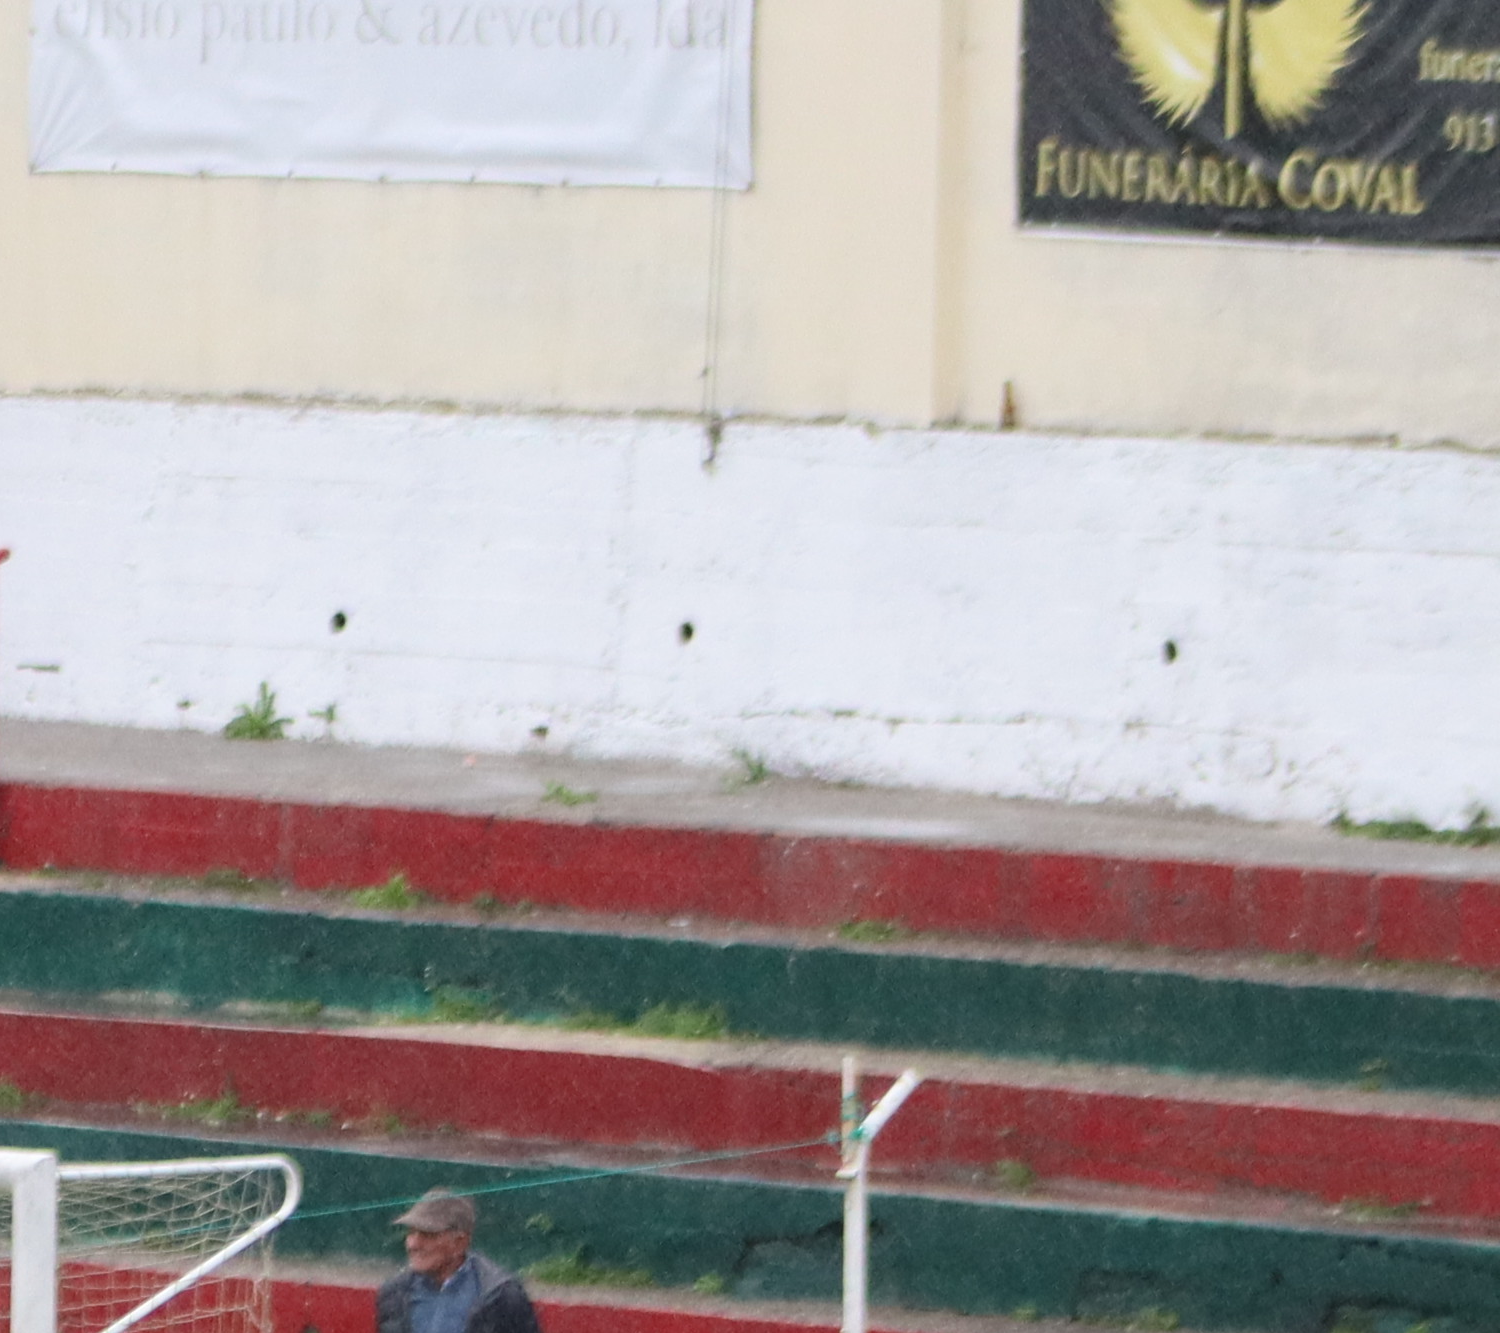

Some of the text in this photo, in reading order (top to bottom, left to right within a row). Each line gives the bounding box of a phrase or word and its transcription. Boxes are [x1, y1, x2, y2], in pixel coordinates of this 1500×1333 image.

[199, 0, 336, 64] paulo
[354, 0, 401, 45] &
[1035, 134, 1426, 216] FUNERÁRIA COVAL
